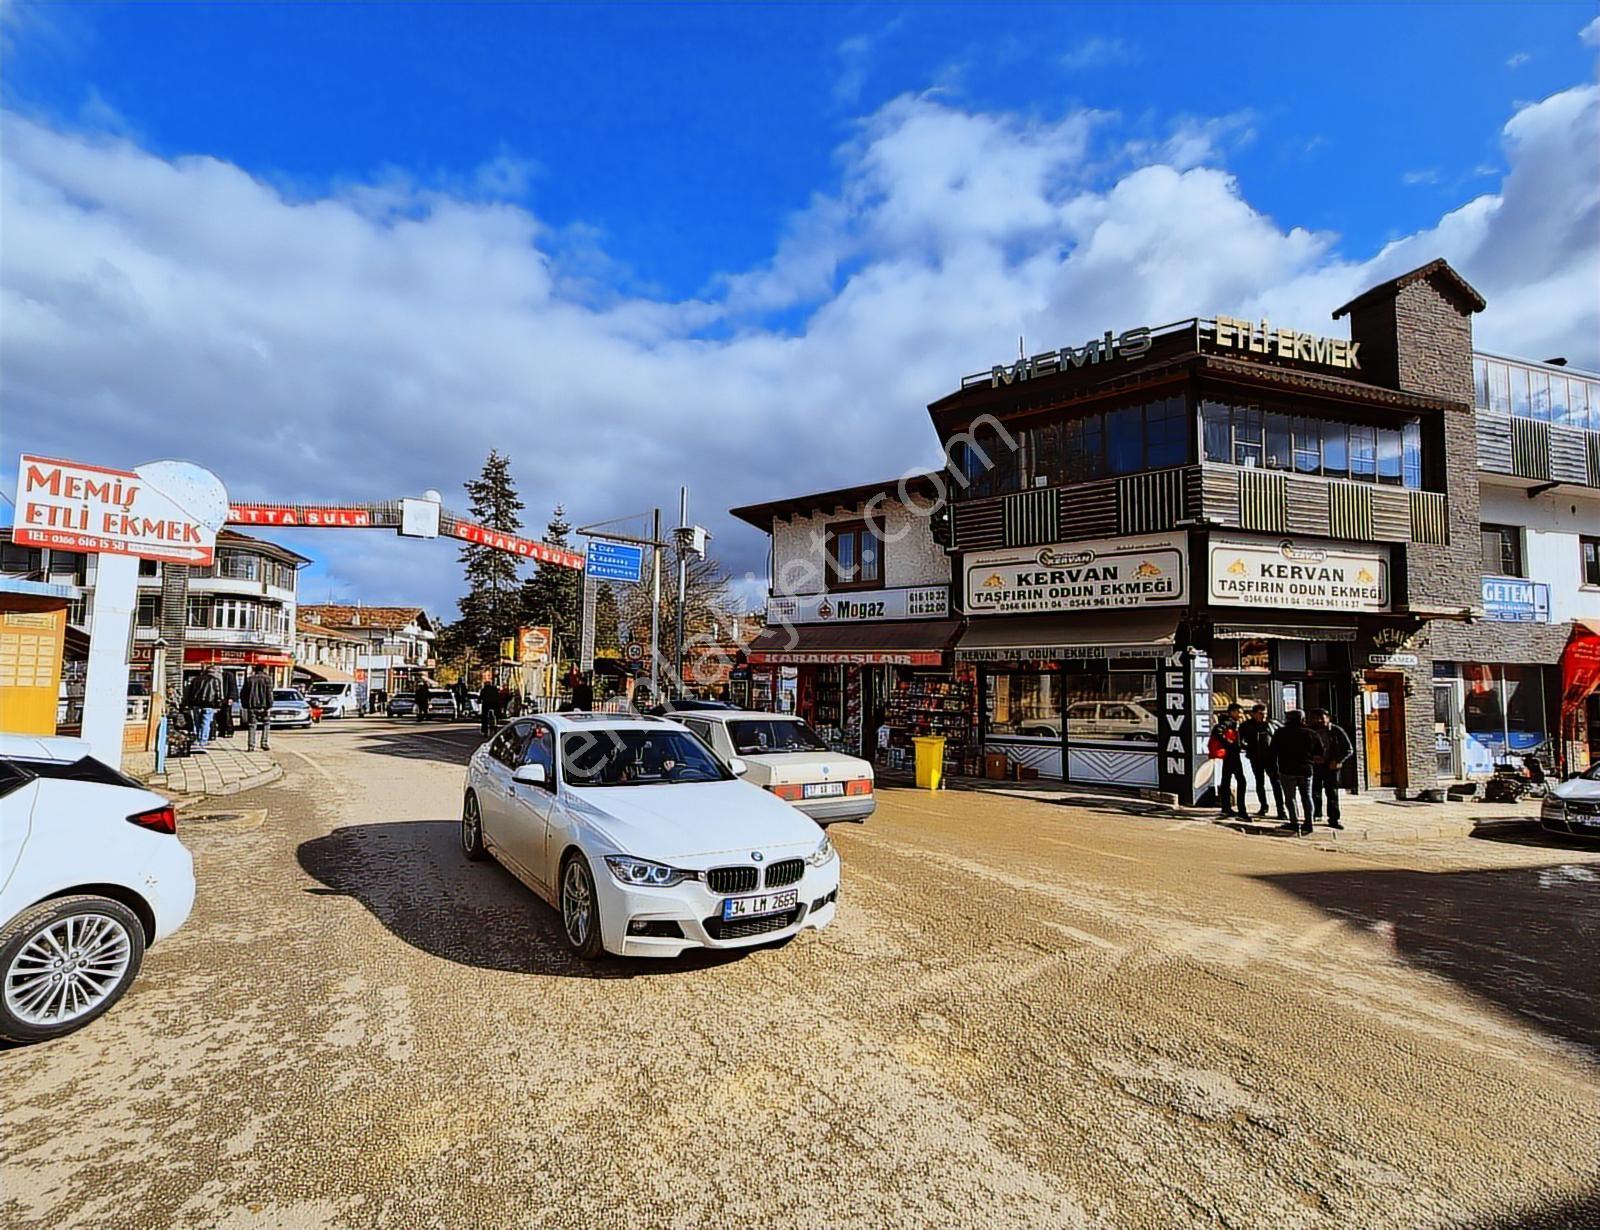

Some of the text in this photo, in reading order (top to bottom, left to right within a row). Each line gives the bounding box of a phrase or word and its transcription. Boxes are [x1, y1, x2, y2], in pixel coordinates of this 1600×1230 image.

[1216, 315, 1361, 370] ETLİ EKMEK
[26, 464, 140, 513] MEMİŞ
[26, 502, 201, 544] ETLİ EKMEK
[229, 509, 367, 526] RTTA SULH
[78, 536, 96, 547] 616
[100, 538, 109, 549] 15
[112, 538, 125, 550] 58
[1016, 566, 1118, 586] KERVAN
[1261, 563, 1344, 582] KERVAN
[975, 577, 1173, 604] TAŞFIRIN ODUN EKMEĞİ
[1289, 583, 1325, 596] ODUN
[1482, 583, 1533, 603] GETEM
[837, 600, 884, 619] Mogaz
[1028, 648, 1056, 659] ODUN
[1165, 650, 1185, 775] KERVAN
[1195, 654, 1210, 755] EKMEK
[732, 901, 745, 915] 34
[753, 896, 767, 912] LM
